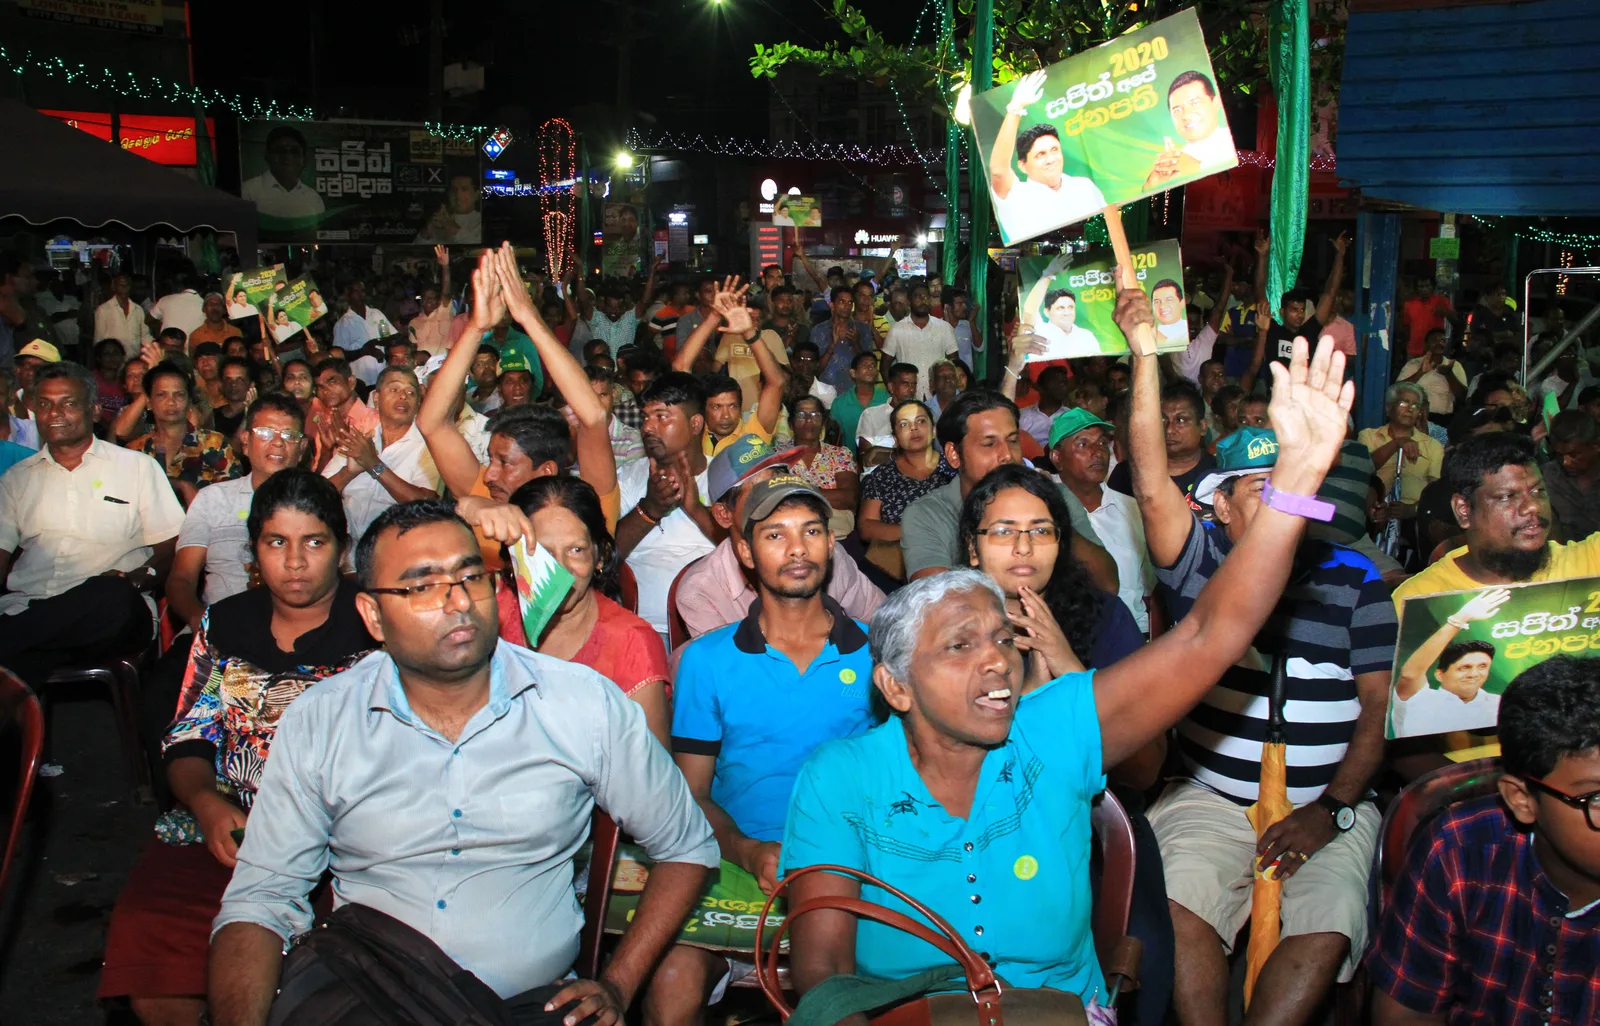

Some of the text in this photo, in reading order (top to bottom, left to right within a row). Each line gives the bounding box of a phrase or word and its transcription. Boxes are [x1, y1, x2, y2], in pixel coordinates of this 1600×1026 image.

[72, 4, 107, 17] TERM
[109, 10, 148, 22] LEASE
[1109, 36, 1169, 77] 2020
[1064, 84, 1159, 136] ජනපති
[871, 234, 900, 243] HUAWE
[1130, 252, 1157, 269] 020
[260, 269, 277, 279] 2020
